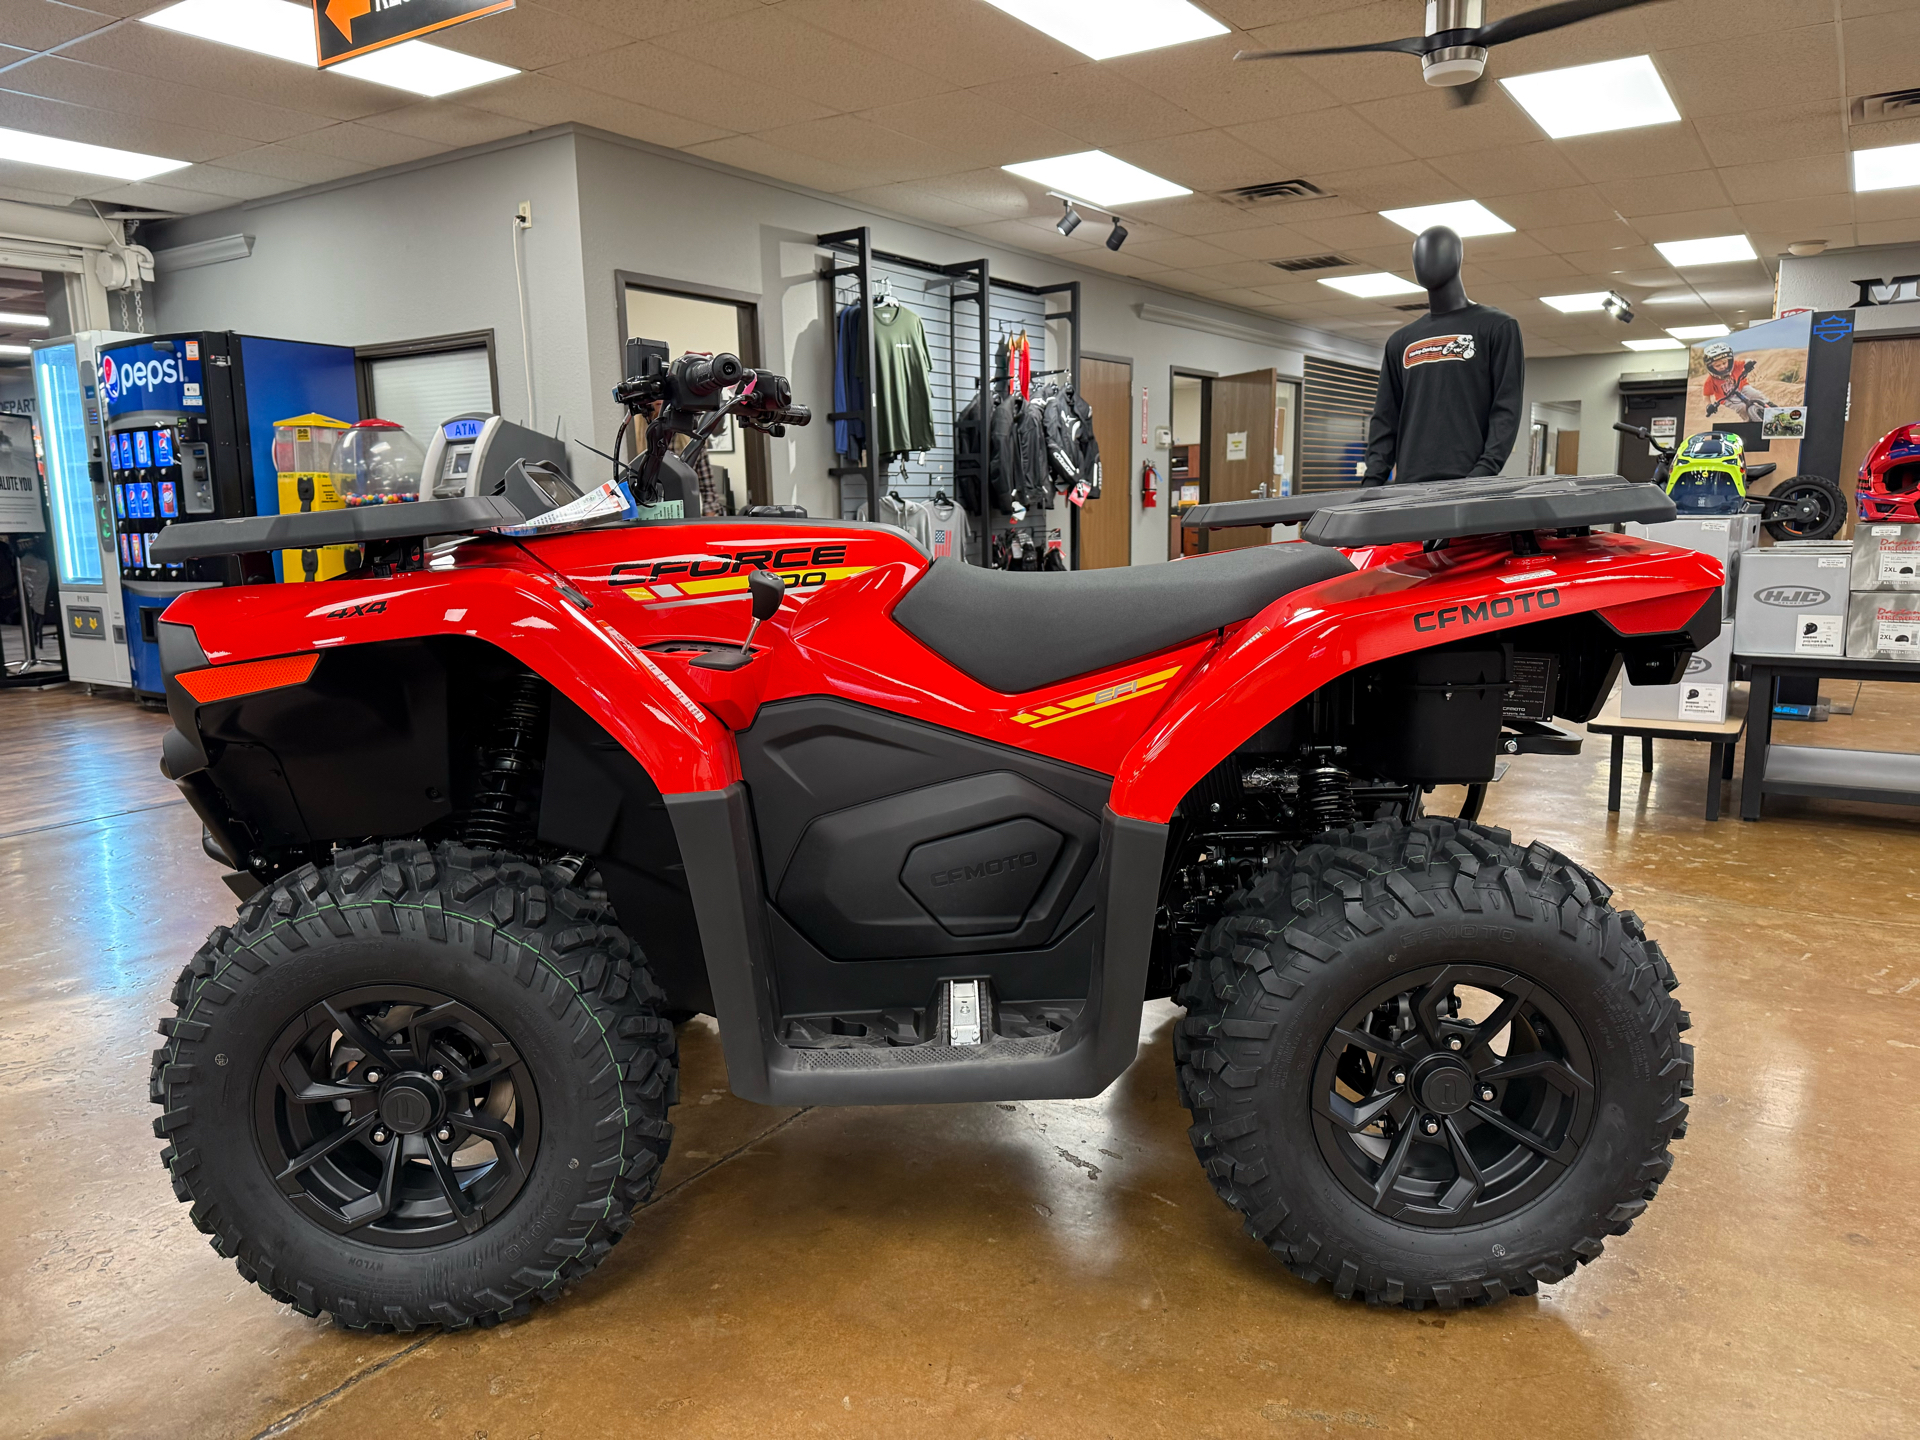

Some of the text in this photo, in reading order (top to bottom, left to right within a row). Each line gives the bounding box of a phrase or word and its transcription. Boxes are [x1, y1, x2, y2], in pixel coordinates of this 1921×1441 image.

[120, 351, 185, 396] pepsi
[455, 422, 477, 436] ATM
[19, 476, 33, 491] YOU
[607, 545, 847, 586] CFORCE
[326, 599, 388, 619] 4X4
[1763, 590, 1822, 603] HJC
[1413, 588, 1560, 633] CFMOTO
[1094, 680, 1138, 705] EFI
[929, 851, 1038, 888] CFMOTO
